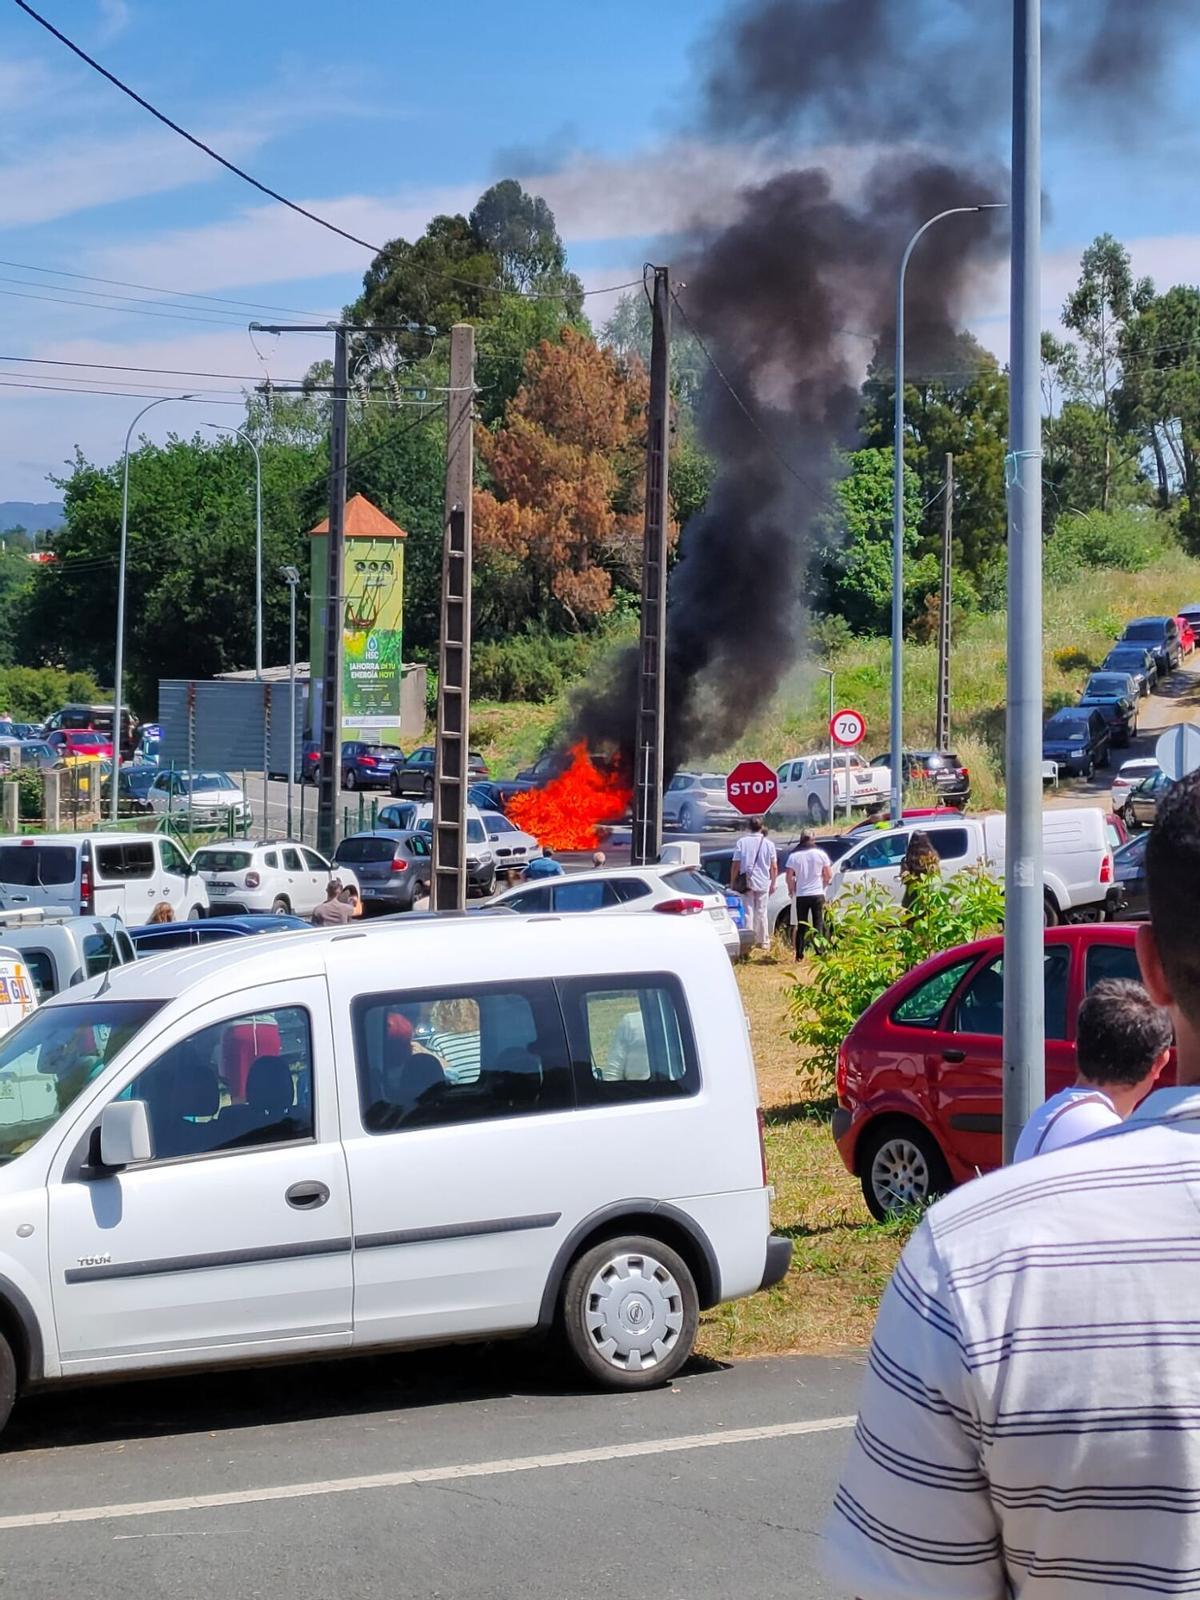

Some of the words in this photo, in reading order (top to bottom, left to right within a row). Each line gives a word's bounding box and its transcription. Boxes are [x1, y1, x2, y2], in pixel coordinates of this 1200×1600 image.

[839, 722, 857, 734] 70
[730, 780, 775, 796] STOP
[10, 979, 29, 999] GIL
